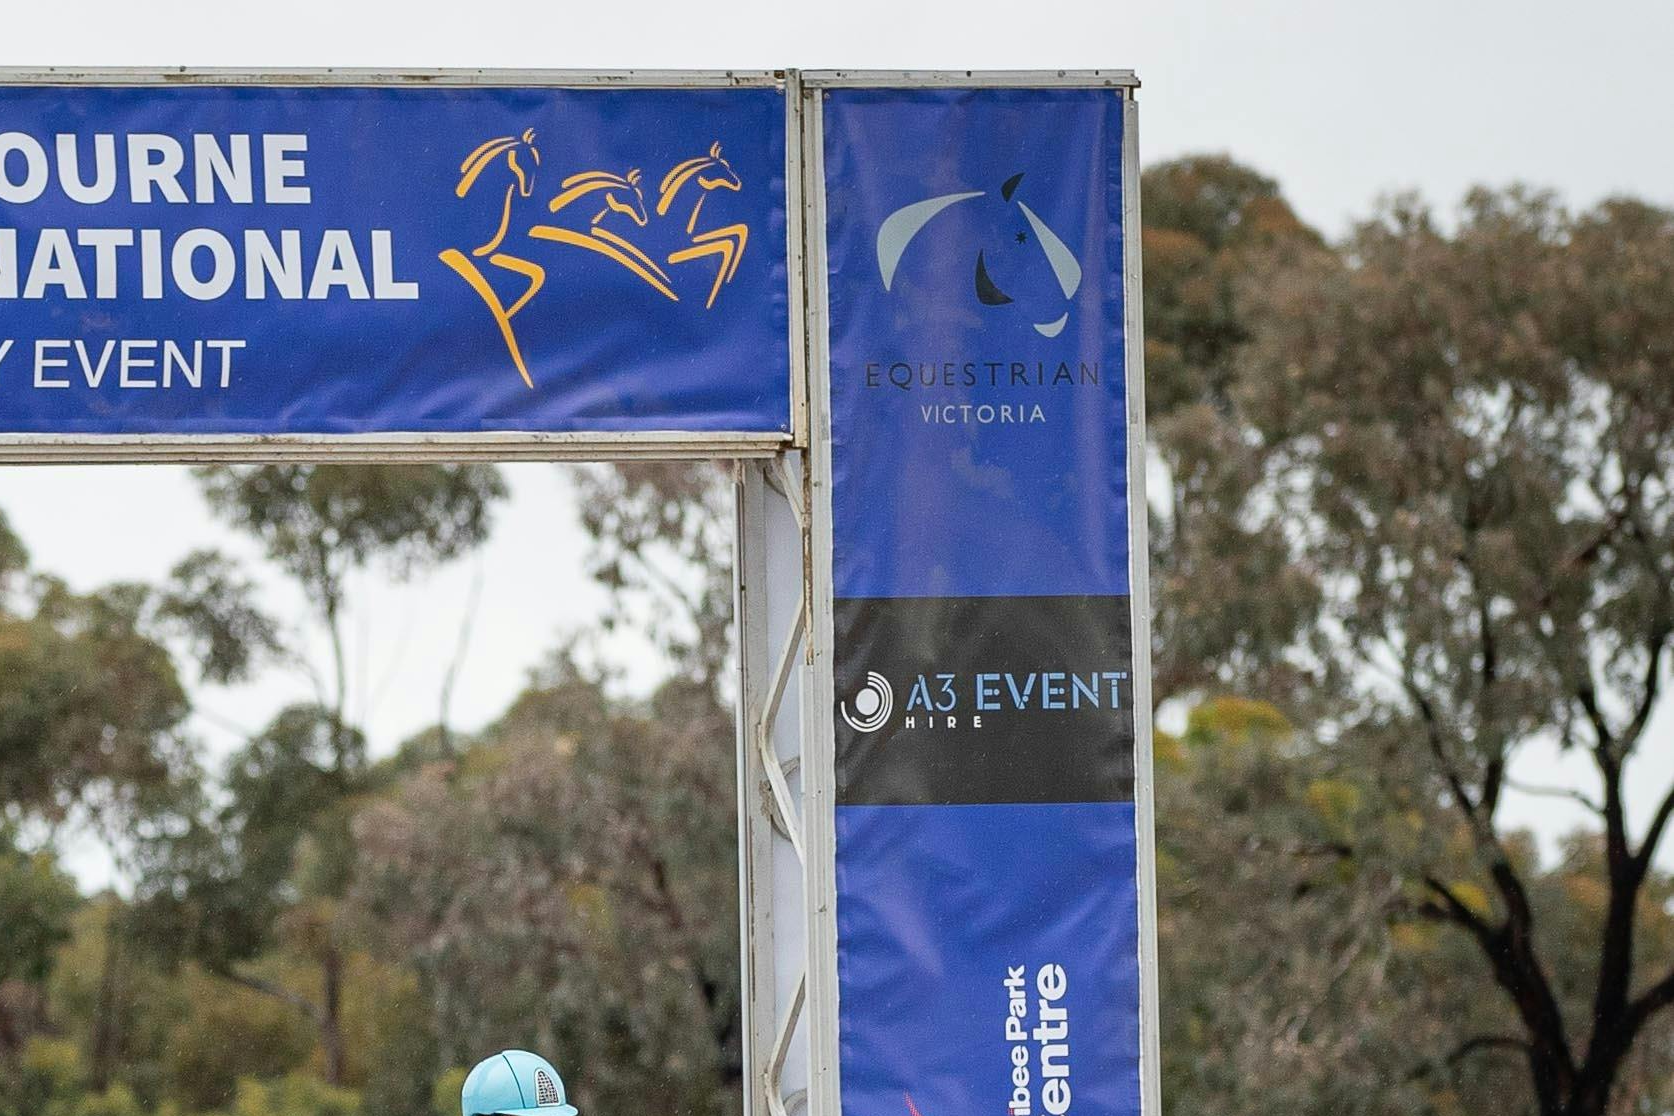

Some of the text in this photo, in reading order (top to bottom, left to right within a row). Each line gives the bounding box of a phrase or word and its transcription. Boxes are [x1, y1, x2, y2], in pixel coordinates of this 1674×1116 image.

[33, 340, 247, 389] EVENT
[865, 361, 1099, 392] EQUESTRIAN
[921, 403, 1046, 425] VICTORIA
[906, 672, 1127, 712] A3 EVENT
[905, 715, 983, 729] HIRE
[1003, 964, 1028, 1042] Park
